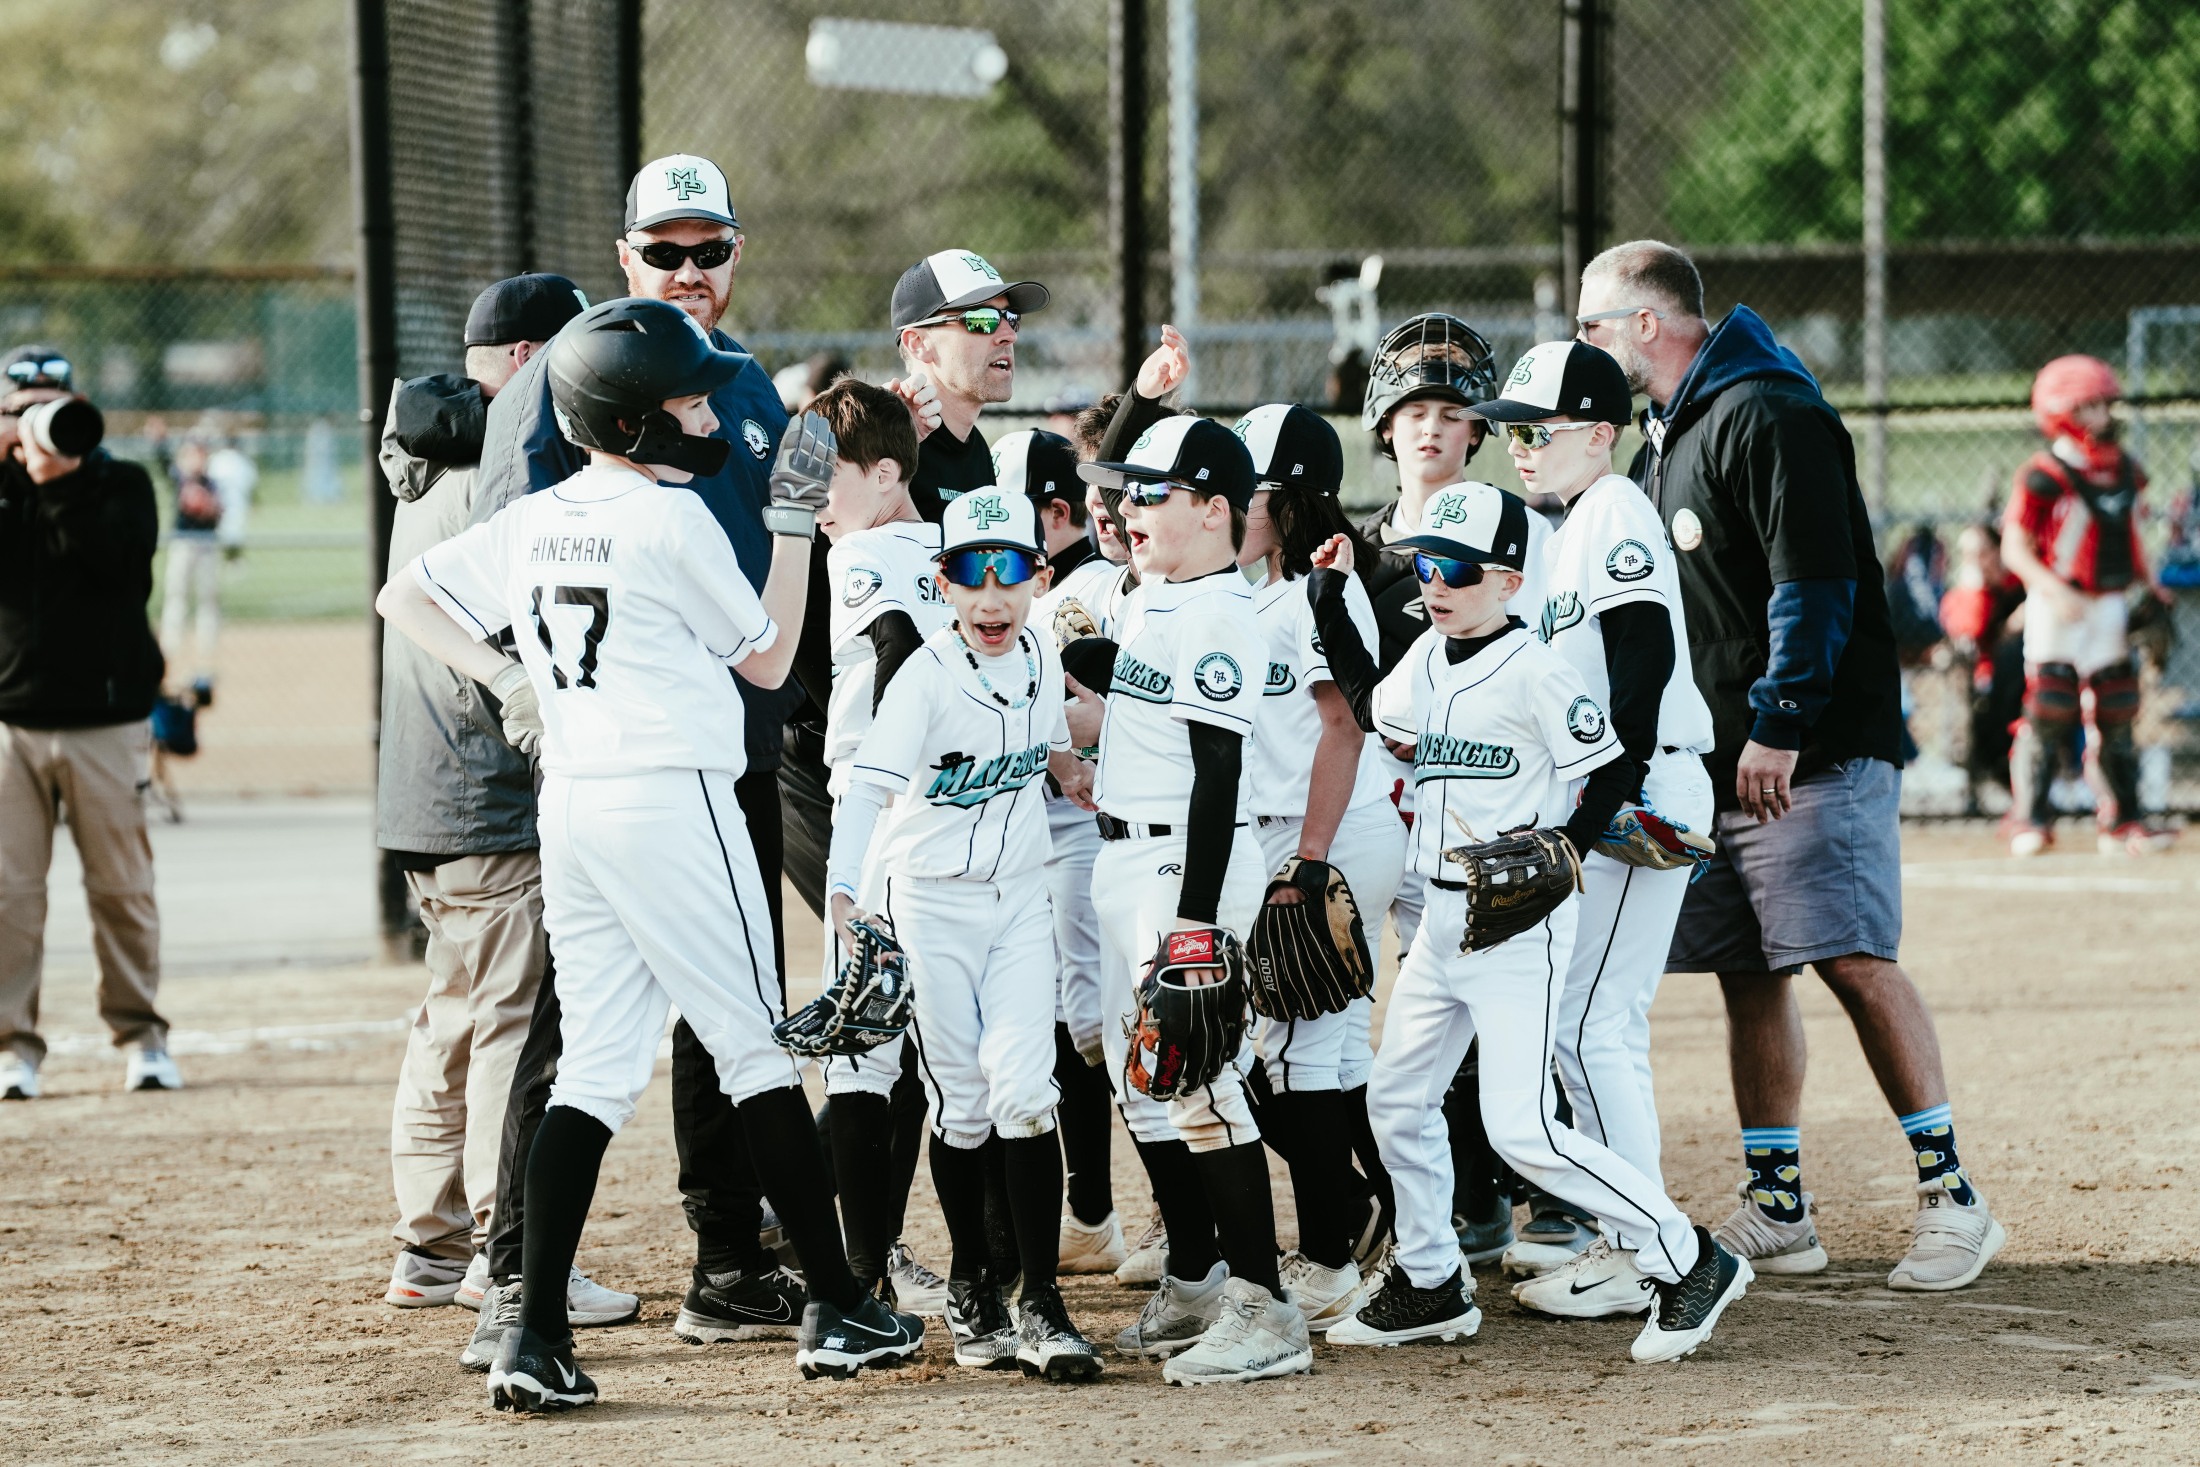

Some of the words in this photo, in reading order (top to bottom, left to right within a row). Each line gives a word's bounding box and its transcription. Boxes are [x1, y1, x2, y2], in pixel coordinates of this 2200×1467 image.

[531, 537, 613, 563] HINEMAN
[1626, 541, 1652, 561] PROSPECT
[531, 585, 610, 690] 17
[1200, 656, 1218, 669] MOUNT
[1220, 656, 1239, 681] PROSPECT
[1200, 685, 1234, 698] MAVERICKS
[823, 1337, 846, 1349] NIKE
